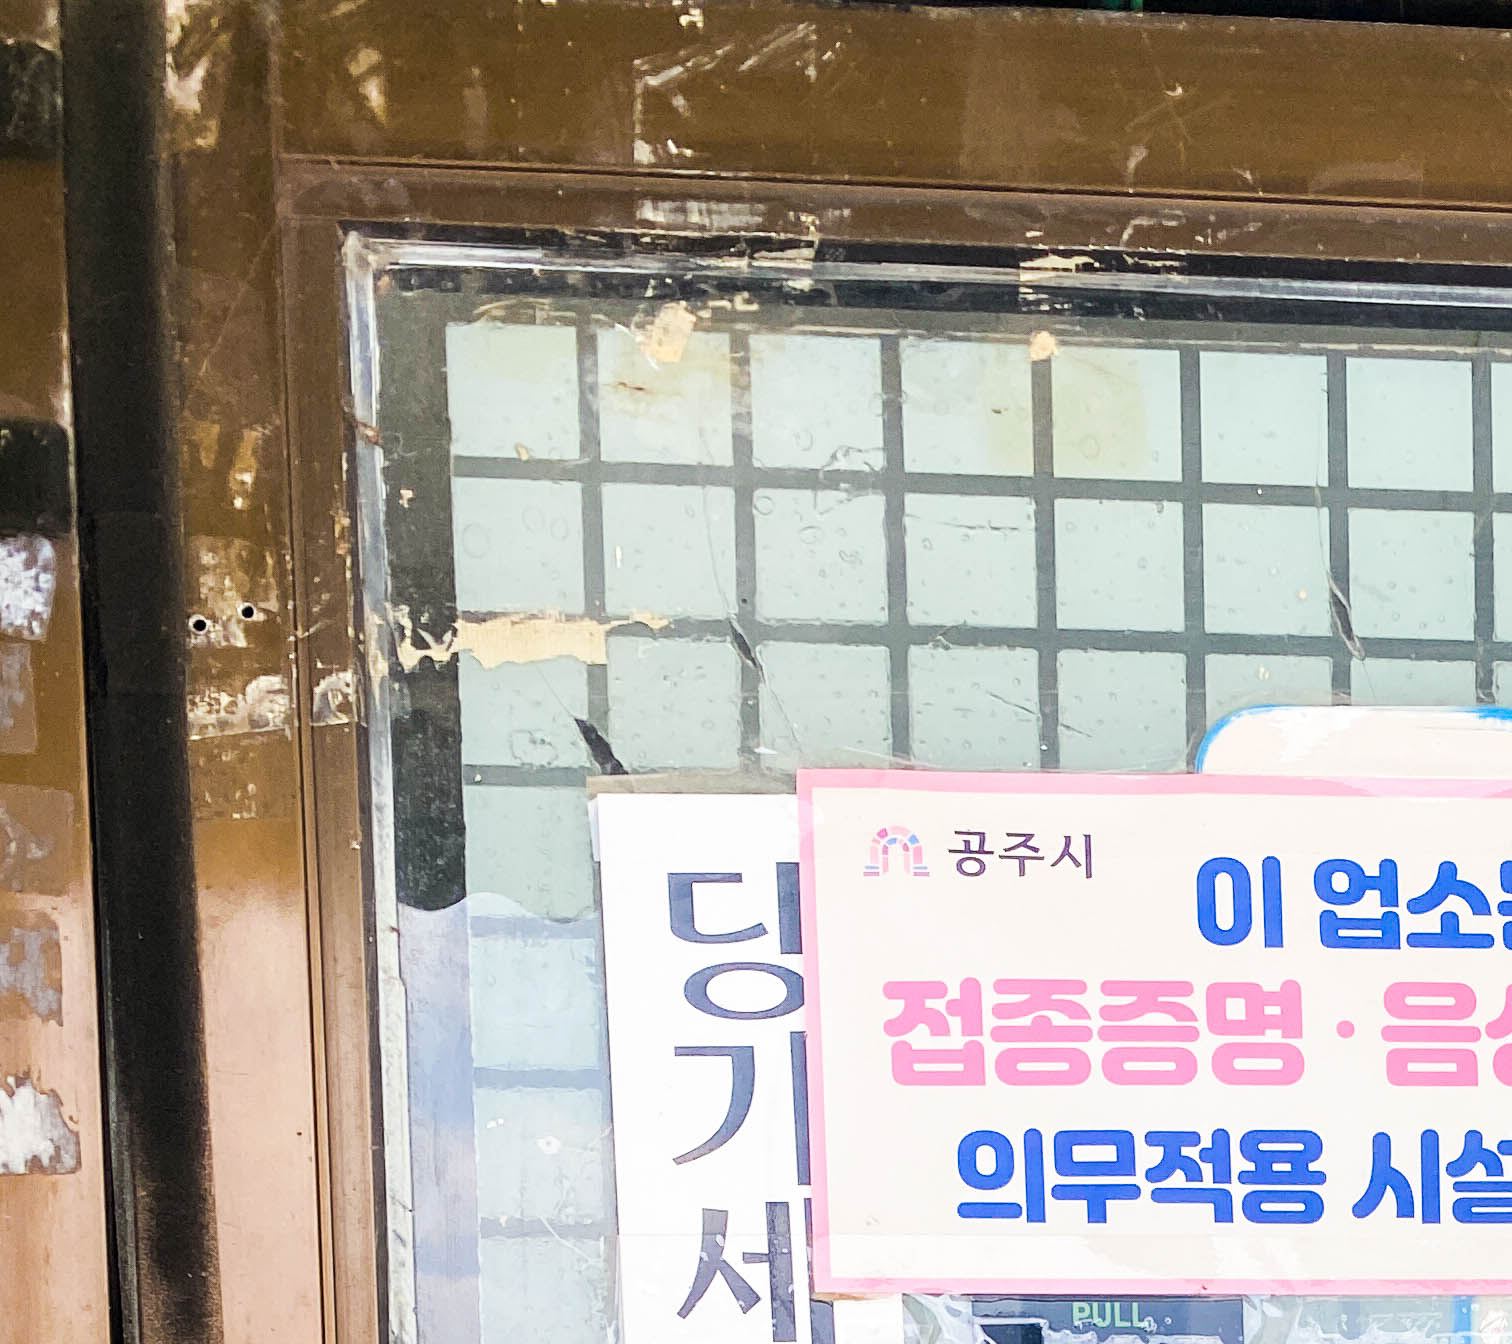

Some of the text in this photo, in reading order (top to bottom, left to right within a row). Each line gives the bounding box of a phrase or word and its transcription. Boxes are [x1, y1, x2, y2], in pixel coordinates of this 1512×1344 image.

[947, 829, 1095, 880] 공주시
[1196, 855, 1285, 949] 이
[956, 1127, 1327, 1225] 의무적용
[1072, 1301, 1152, 1329] PULL
